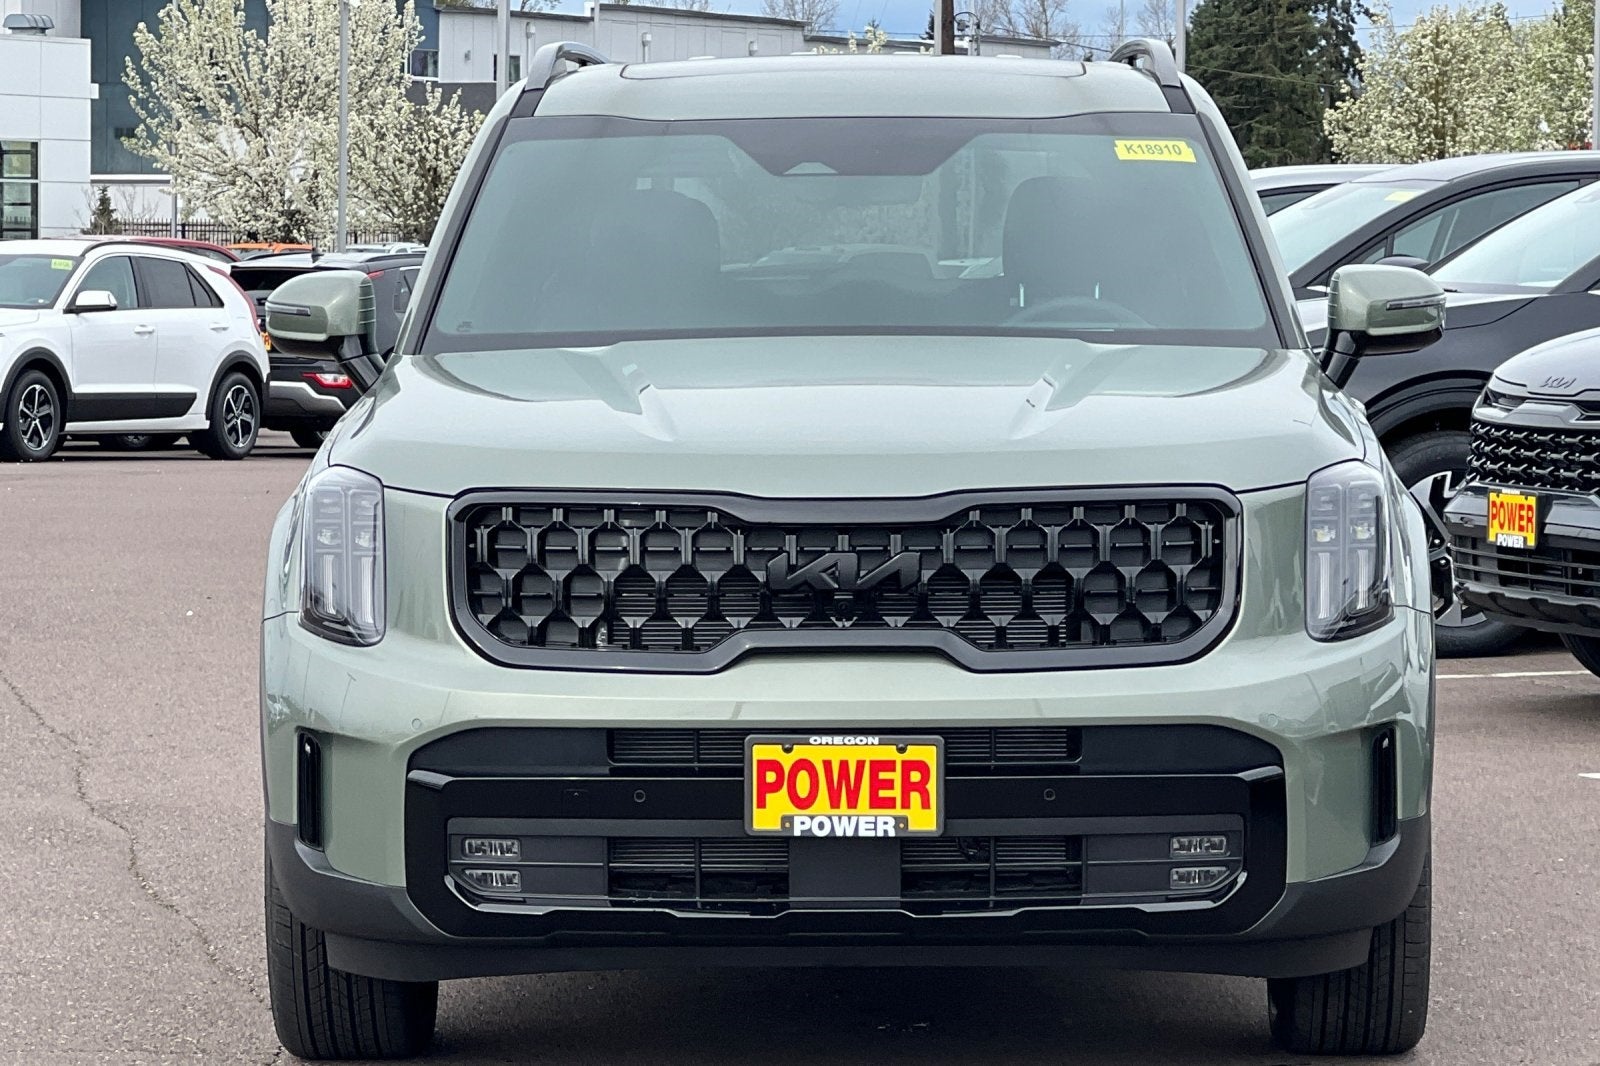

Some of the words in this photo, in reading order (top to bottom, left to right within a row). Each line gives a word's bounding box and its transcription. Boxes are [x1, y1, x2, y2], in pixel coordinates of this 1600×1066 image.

[1124, 143, 1182, 156] K18910
[1491, 500, 1535, 534] POWER
[1497, 533, 1524, 549] POWER
[809, 736, 880, 745] OREGON
[756, 758, 931, 810] POWER
[793, 815, 896, 837] POWER
